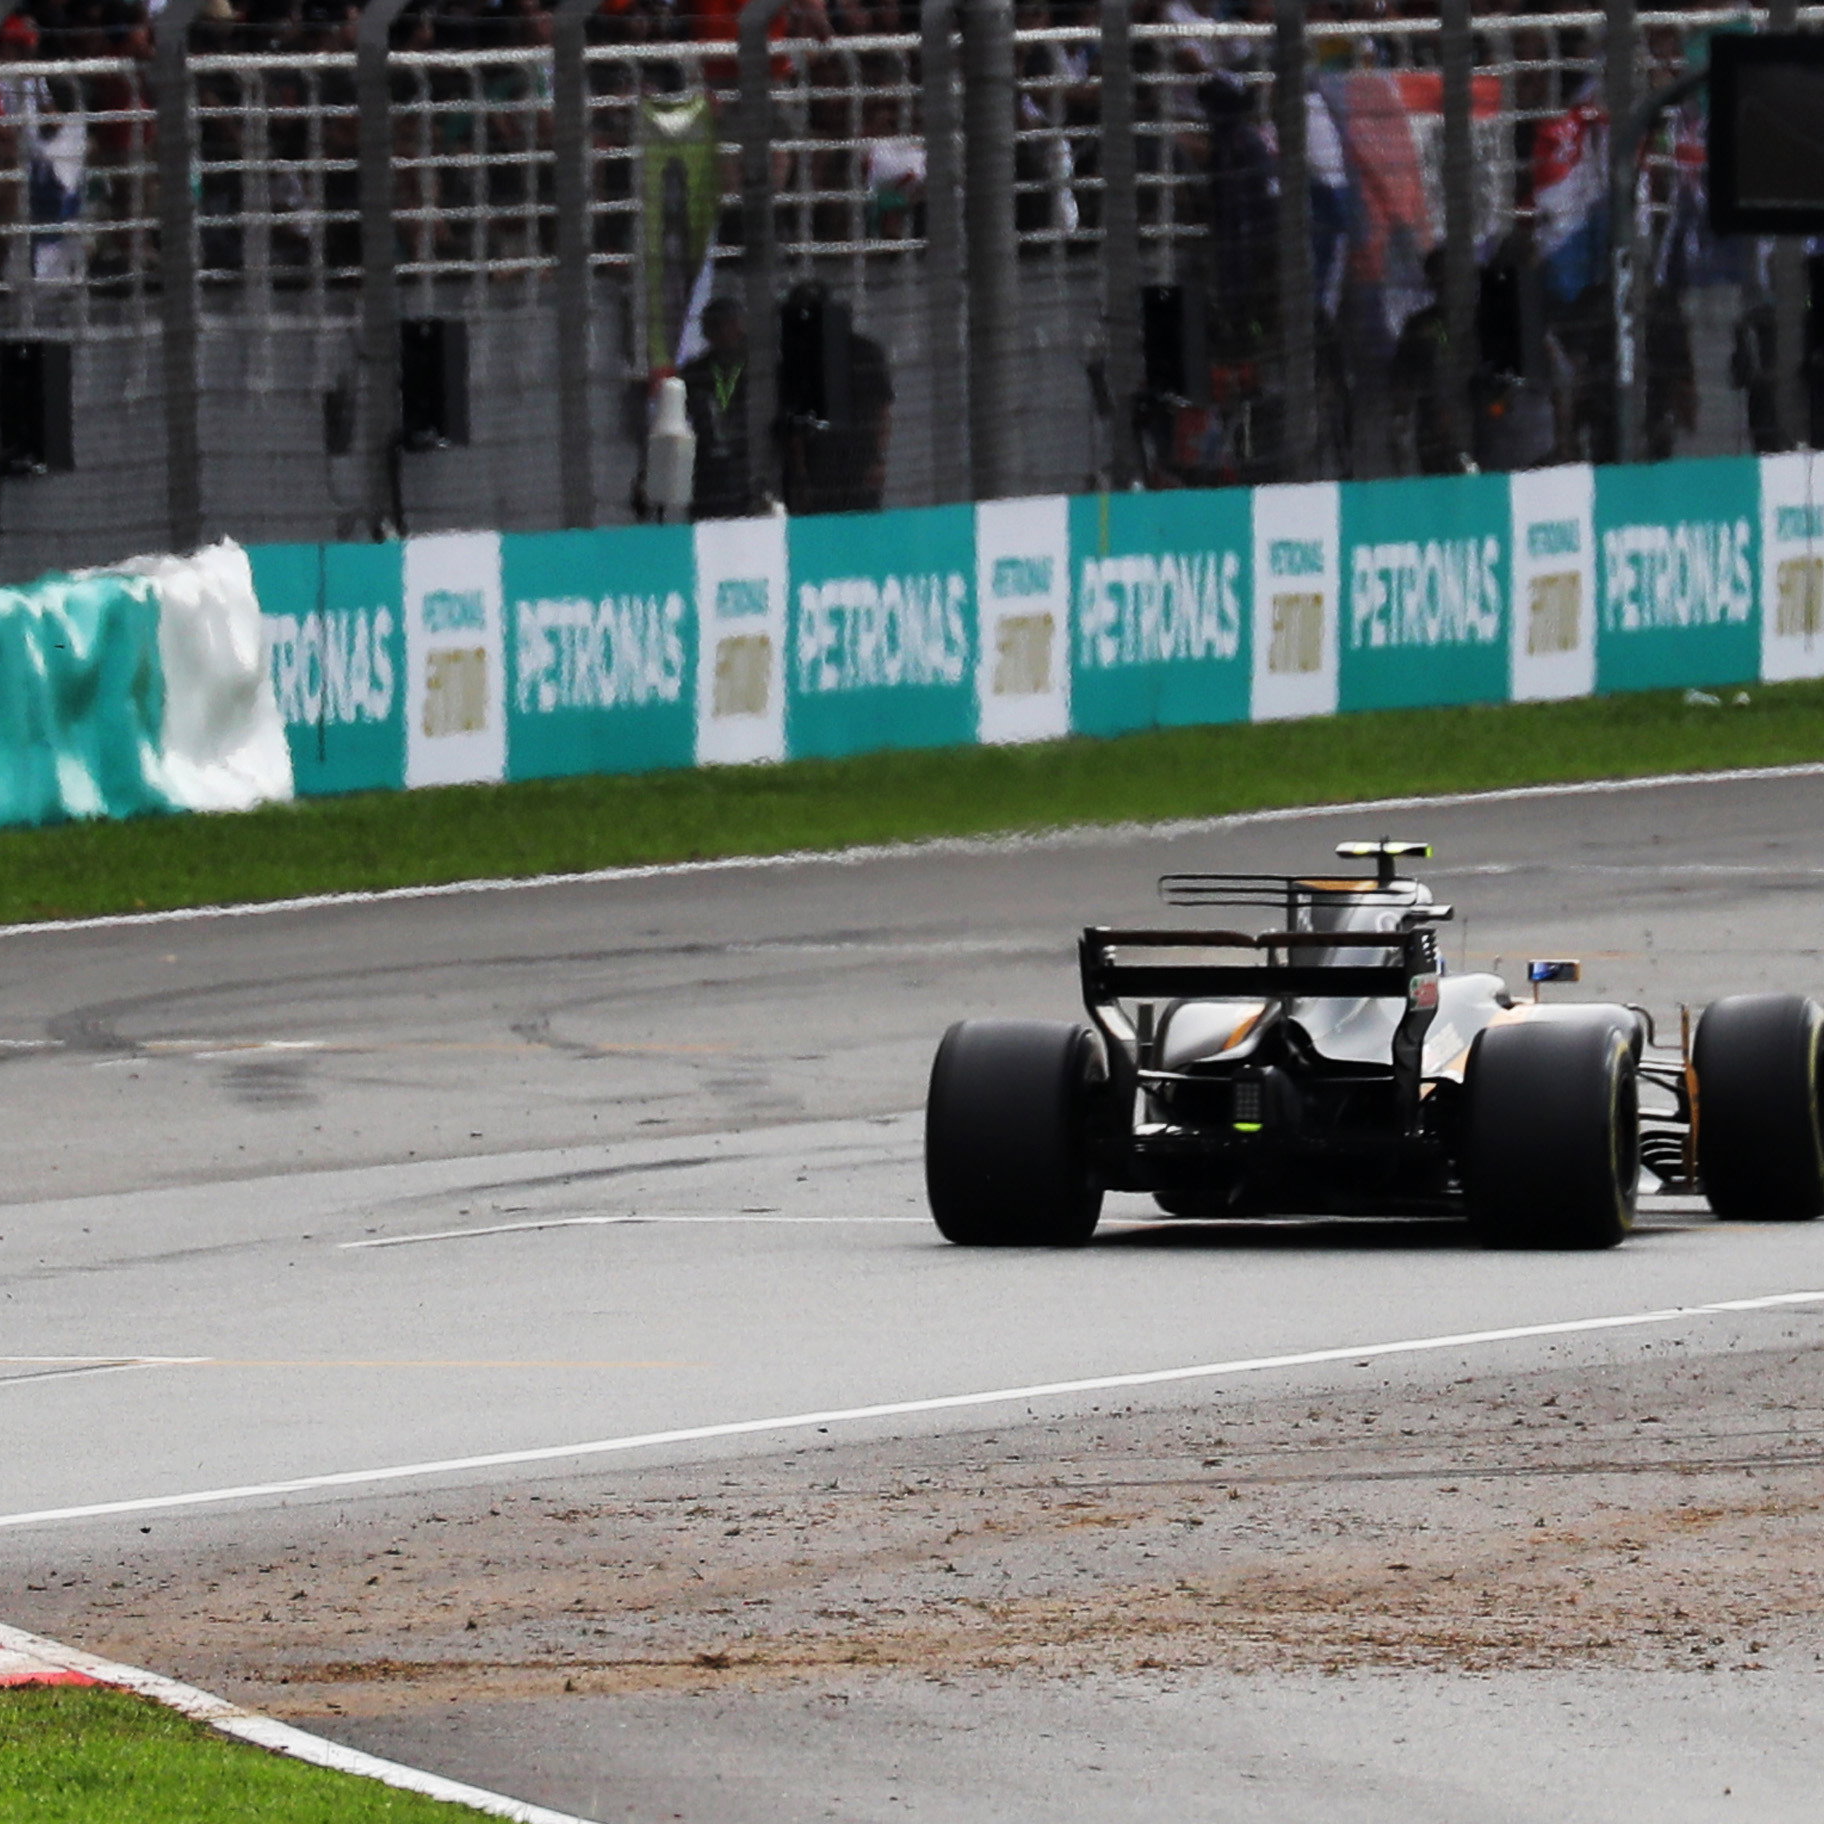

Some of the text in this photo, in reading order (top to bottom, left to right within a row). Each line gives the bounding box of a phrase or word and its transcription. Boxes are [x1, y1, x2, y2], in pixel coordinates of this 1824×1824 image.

[798, 572, 966, 693] PETRONAS
[1081, 551, 1239, 668] PETRONAS
[1351, 537, 1499, 649] PETRONAS
[1605, 518, 1751, 632] PETRONAS
[260, 606, 393, 725] TRONAS
[516, 592, 683, 714] PETRONAS
